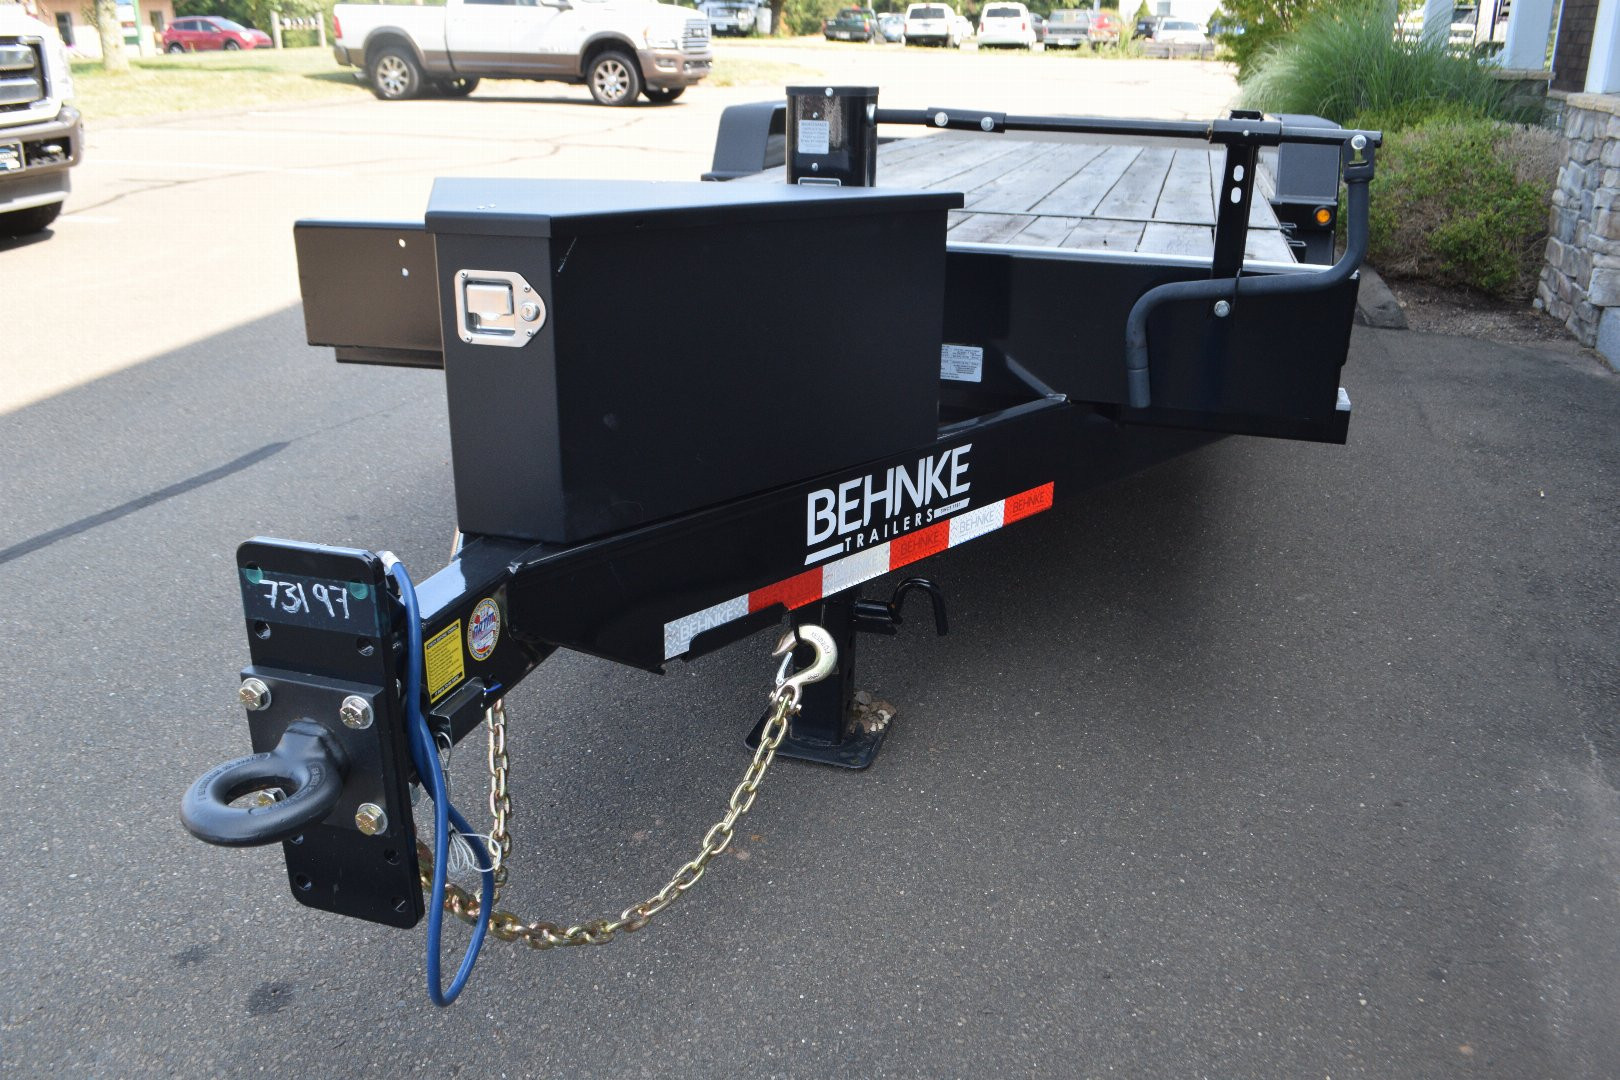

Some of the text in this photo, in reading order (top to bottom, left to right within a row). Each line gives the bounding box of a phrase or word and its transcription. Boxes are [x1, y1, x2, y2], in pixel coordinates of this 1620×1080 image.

[807, 443, 972, 546] BEHNKE
[1012, 491, 1045, 513] BEHNKE
[845, 508, 935, 552] TRAILERS
[959, 510, 995, 533] BEHNKE
[900, 531, 938, 556] BEHNKE
[259, 579, 349, 619] 73197
